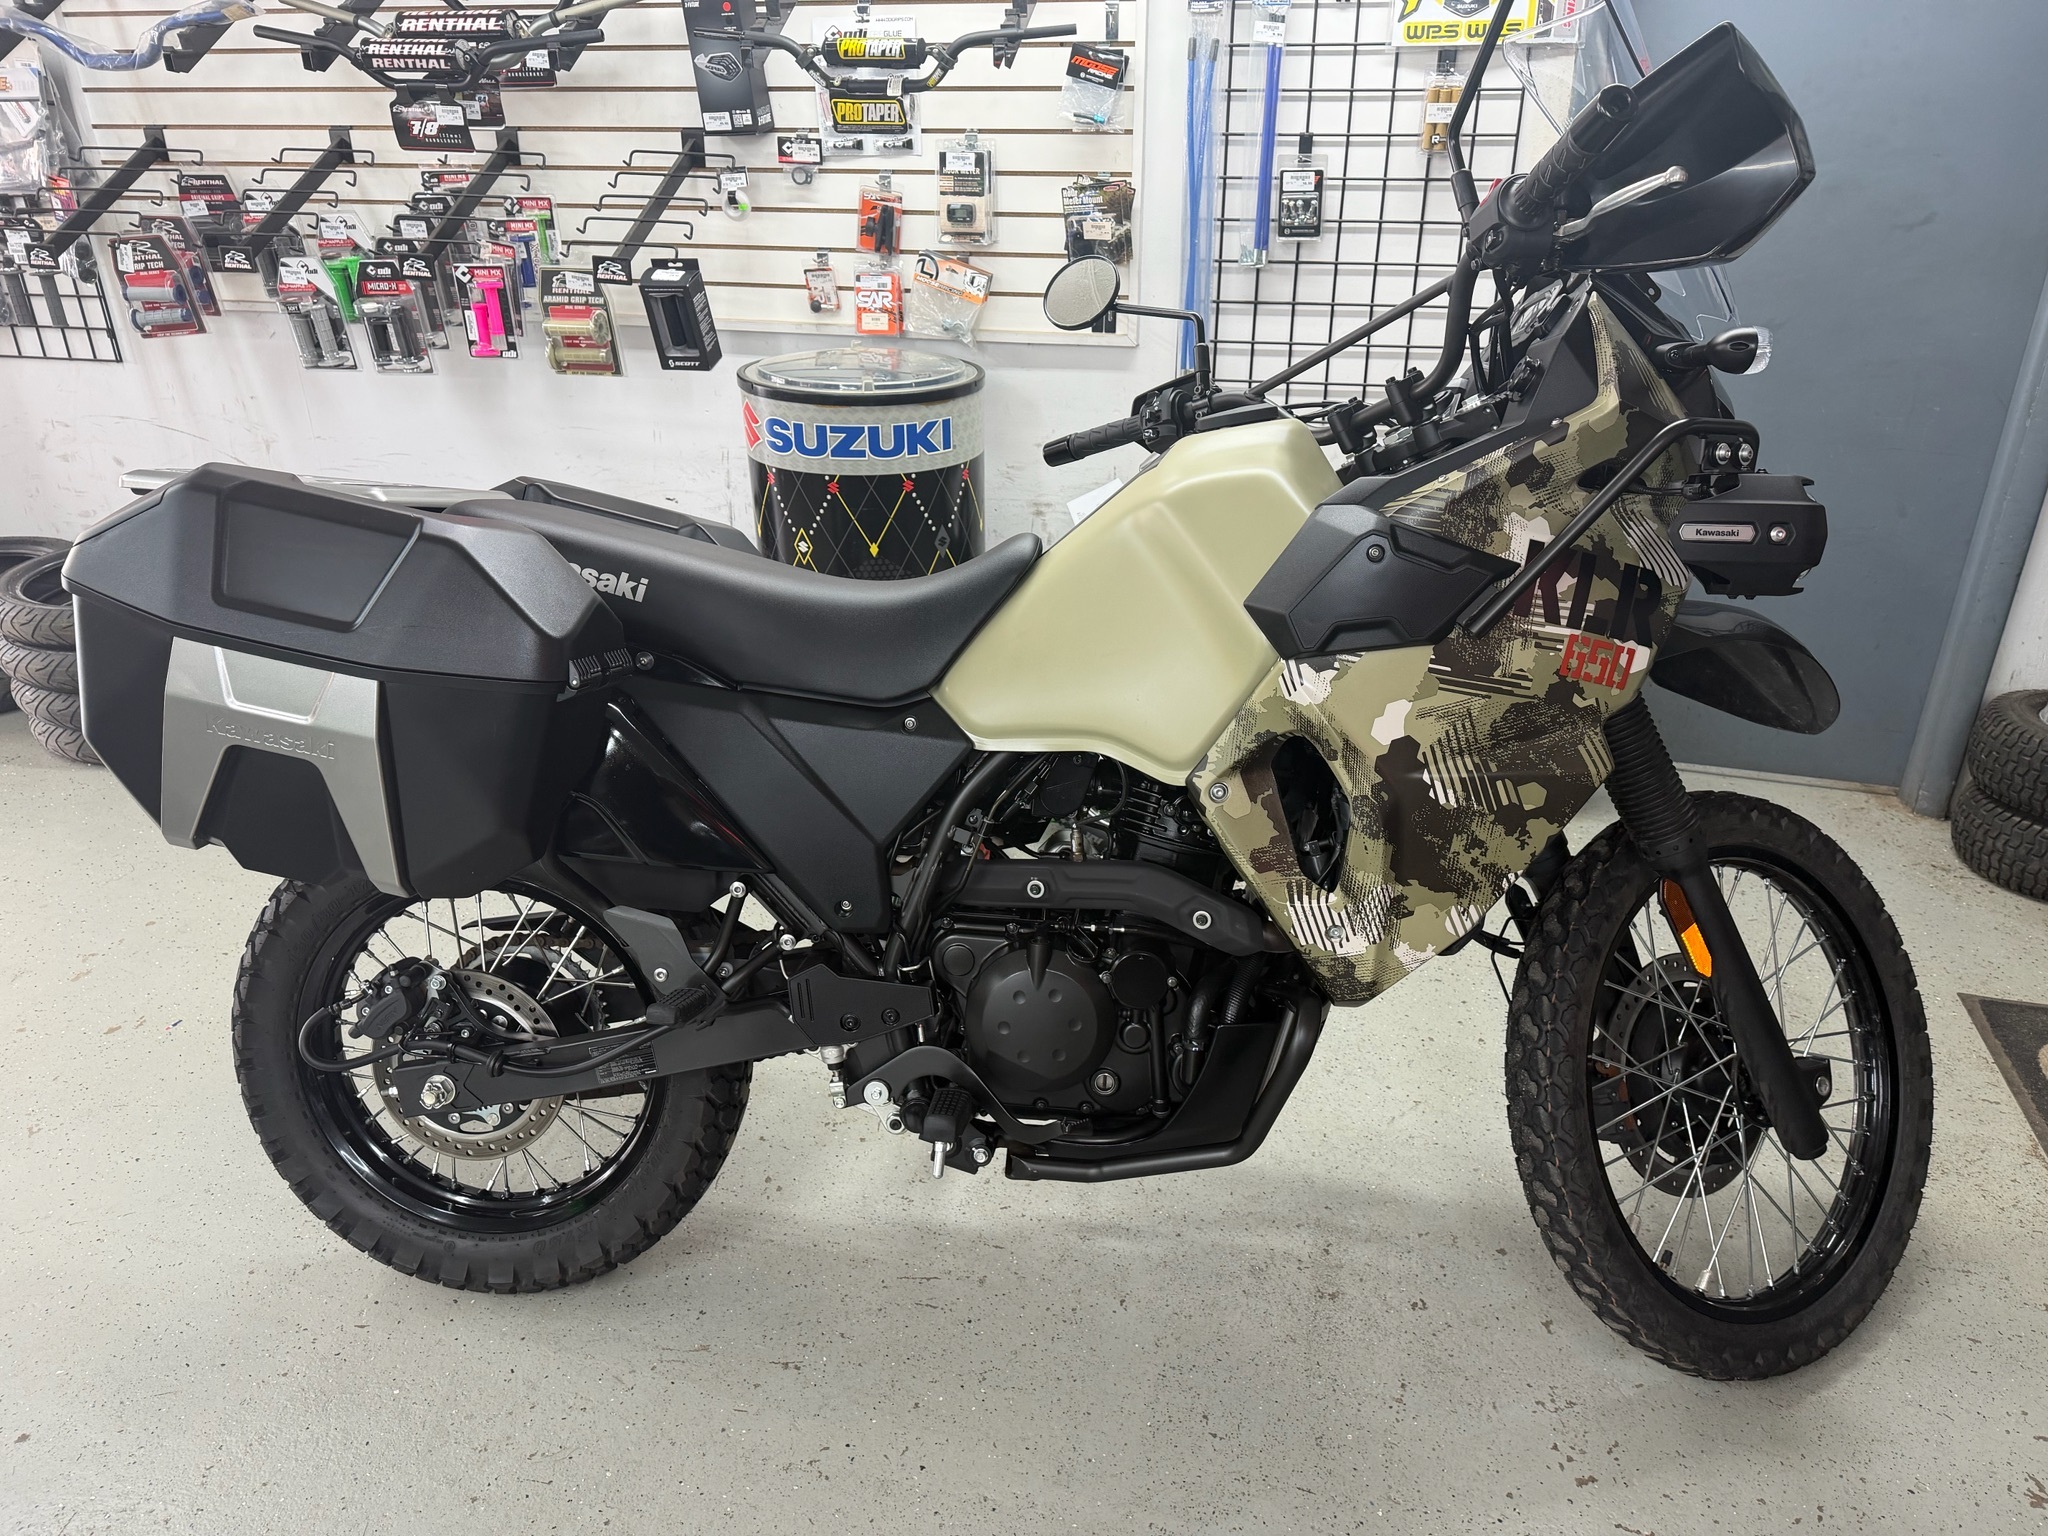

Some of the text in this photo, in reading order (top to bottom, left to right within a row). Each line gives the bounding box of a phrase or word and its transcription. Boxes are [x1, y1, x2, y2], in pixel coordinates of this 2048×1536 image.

[400, 17, 504, 32] RENTHAL
[1406, 21, 1523, 39] WPS WS
[883, 29, 903, 37] GLUE
[368, 44, 448, 55] RENTHAL
[371, 58, 451, 69] RENTHAL
[147, 261, 164, 269] TECH
[224, 262, 252, 270] RENTHAL
[402, 270, 432, 278] RENTHAL
[596, 273, 628, 281] RENTHAL
[543, 295, 569, 303] ARAMID
[588, 296, 604, 304] TECH
[856, 291, 893, 308] SAR
[764, 416, 953, 460] SUZUKI
[1695, 528, 1740, 537] Kawasaki
[1513, 539, 1663, 648] KLR
[1559, 633, 1636, 690] 650
[206, 712, 335, 760] Kawasaki
